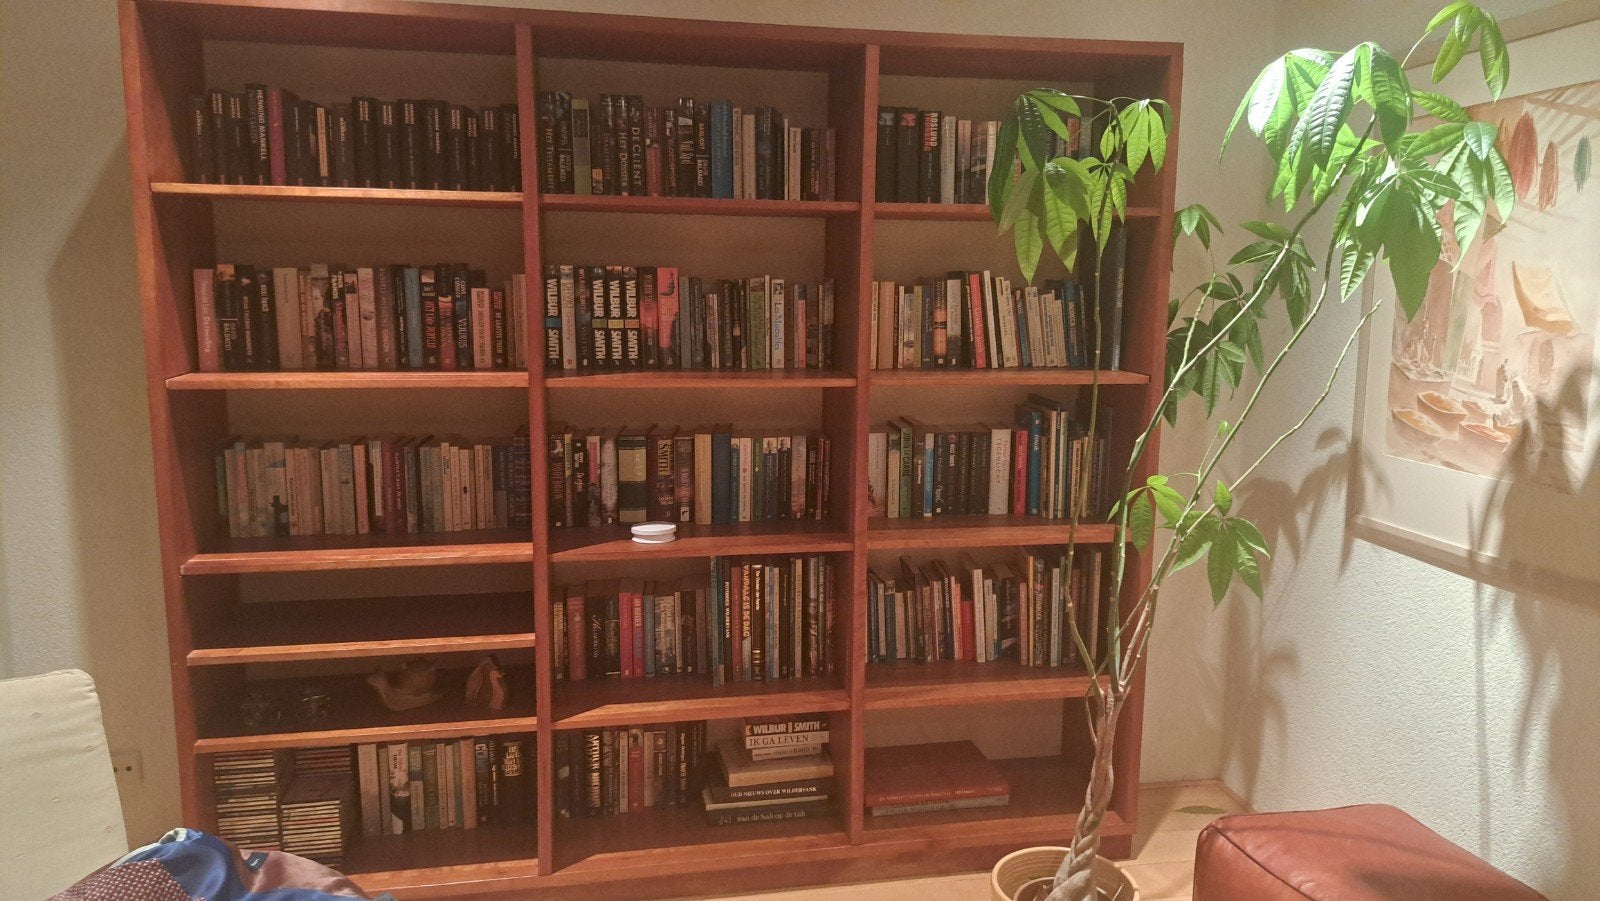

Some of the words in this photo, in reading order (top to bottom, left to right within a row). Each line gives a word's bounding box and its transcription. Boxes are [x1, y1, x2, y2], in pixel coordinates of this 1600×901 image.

[618, 132, 627, 148] HET
[632, 127, 640, 142] DE
[618, 153, 628, 188] DOSSIER
[696, 160, 704, 188] BALDACCI
[547, 278, 558, 316] WILBUR
[592, 280, 604, 318] WILBUR
[610, 280, 621, 318] WILBUR
[626, 280, 637, 318] WILBUR
[382, 329, 390, 352] GIDEON
[548, 328, 559, 359] SMITH
[594, 330, 606, 360] SMITH
[611, 330, 622, 360] SMITH
[628, 330, 638, 360] SMITH
[902, 432, 910, 450] JOHN
[658, 444, 670, 476] SMITH
[742, 565, 750, 603] VANDAAG
[743, 611, 750, 621] DE
[743, 622, 751, 638] DAG
[750, 737, 760, 746] IK
[762, 736, 775, 745] GA
[778, 734, 809, 744] LEVEN
[753, 724, 787, 734] WILBUR
[794, 720, 820, 732] SMITH
[592, 734, 600, 770] ARTHUR
[781, 786, 817, 794] WILDERVANK
[760, 812, 774, 820] hak
[774, 812, 784, 820] op
